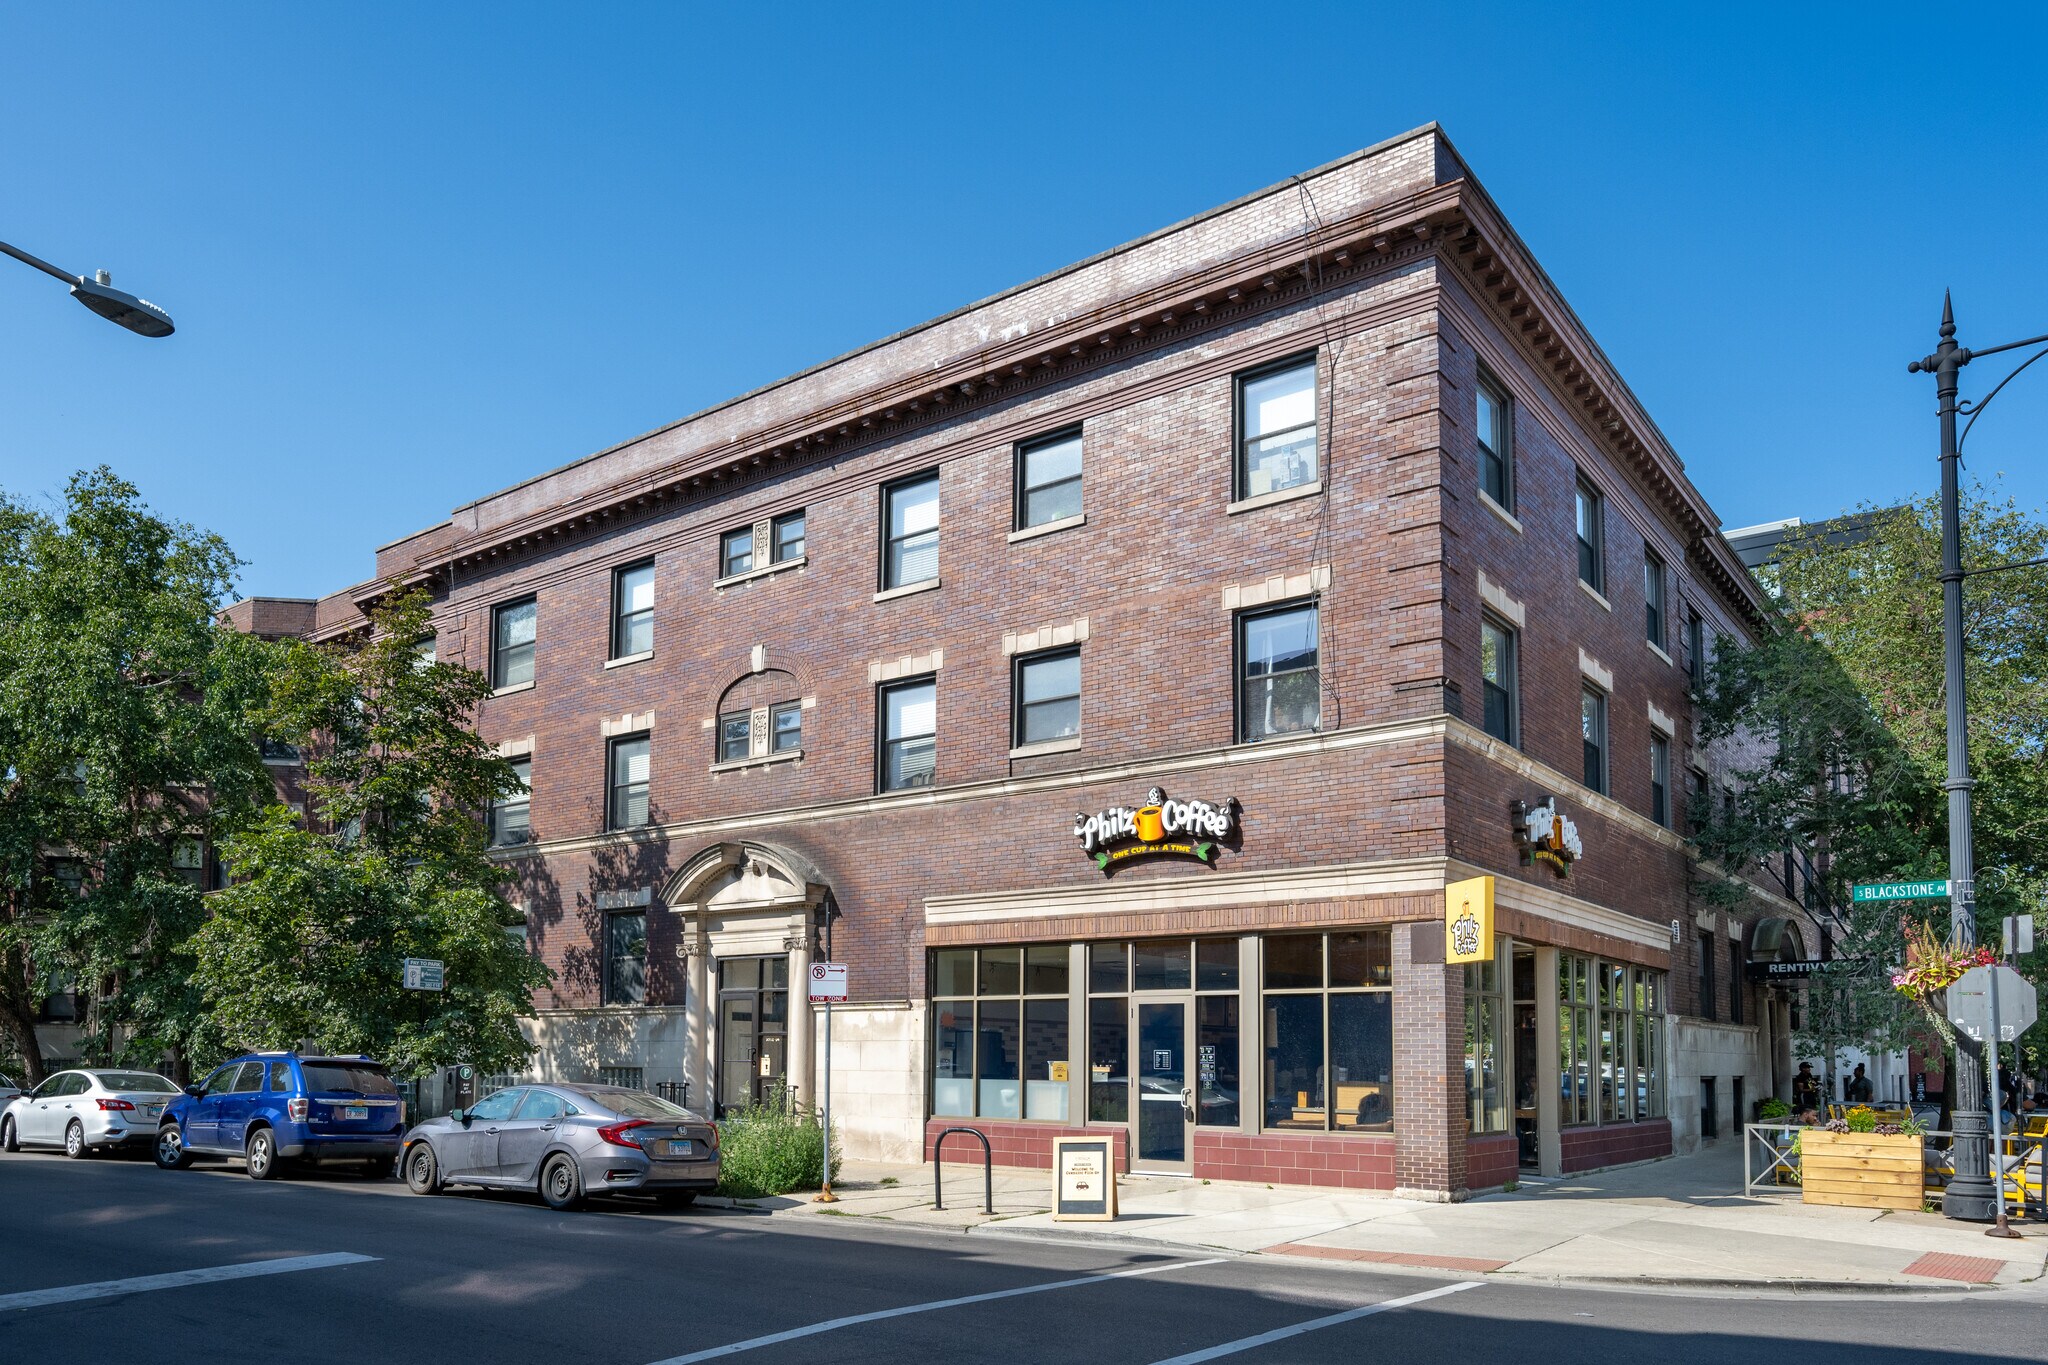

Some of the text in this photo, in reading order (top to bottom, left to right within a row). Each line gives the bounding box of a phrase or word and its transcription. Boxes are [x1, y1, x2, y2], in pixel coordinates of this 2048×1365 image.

[1161, 799, 1231, 836] Coffee
[1112, 849, 1129, 859] ONE
[1131, 846, 1147, 854] CUP
[1170, 844, 1191, 853] TIME
[1864, 884, 1935, 899] BLACKSTONE
[1937, 885, 1945, 893] AV
[1456, 938, 1477, 955] Coffee
